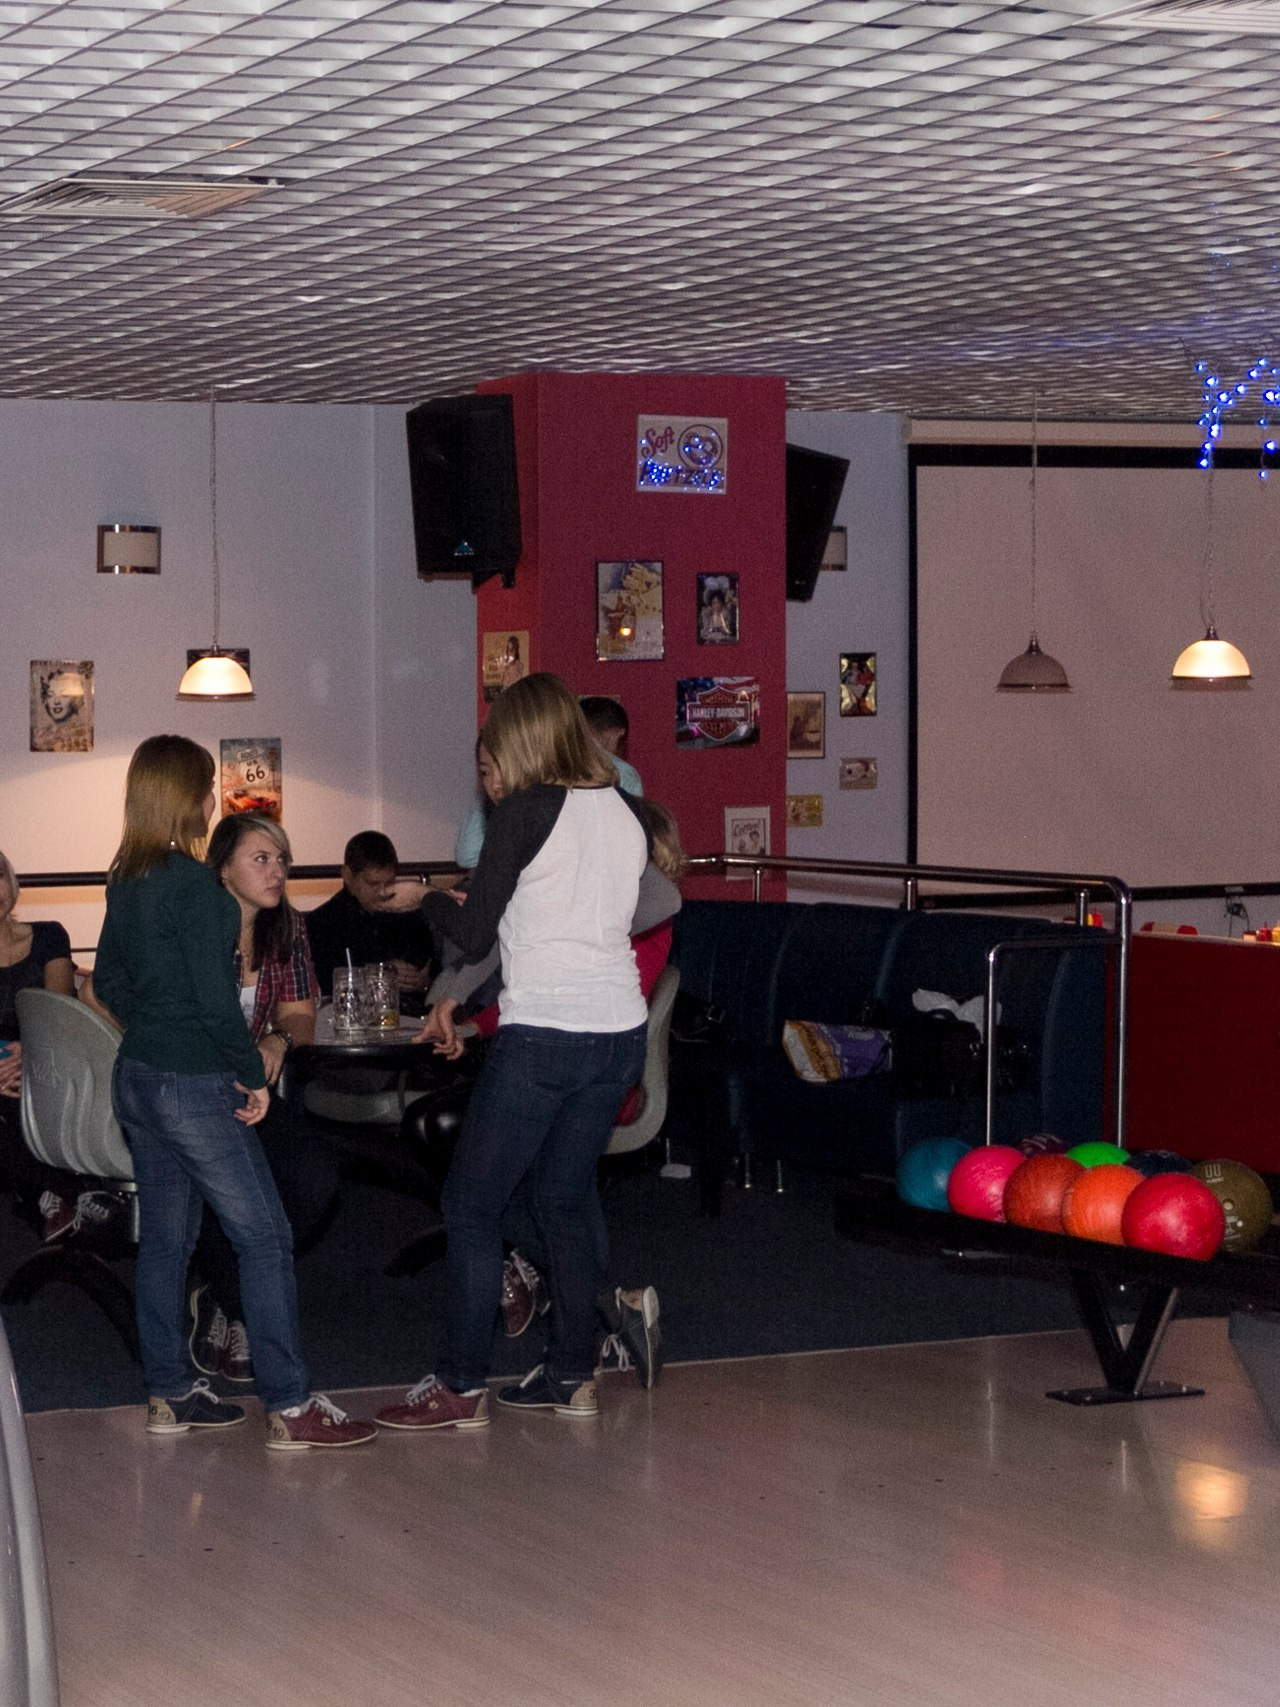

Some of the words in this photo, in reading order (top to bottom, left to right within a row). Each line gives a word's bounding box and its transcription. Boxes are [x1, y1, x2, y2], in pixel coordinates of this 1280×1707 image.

[641, 426, 675, 459] Soft
[692, 707, 745, 719] HARLEY-DAVIDSON
[246, 765, 266, 783] 66
